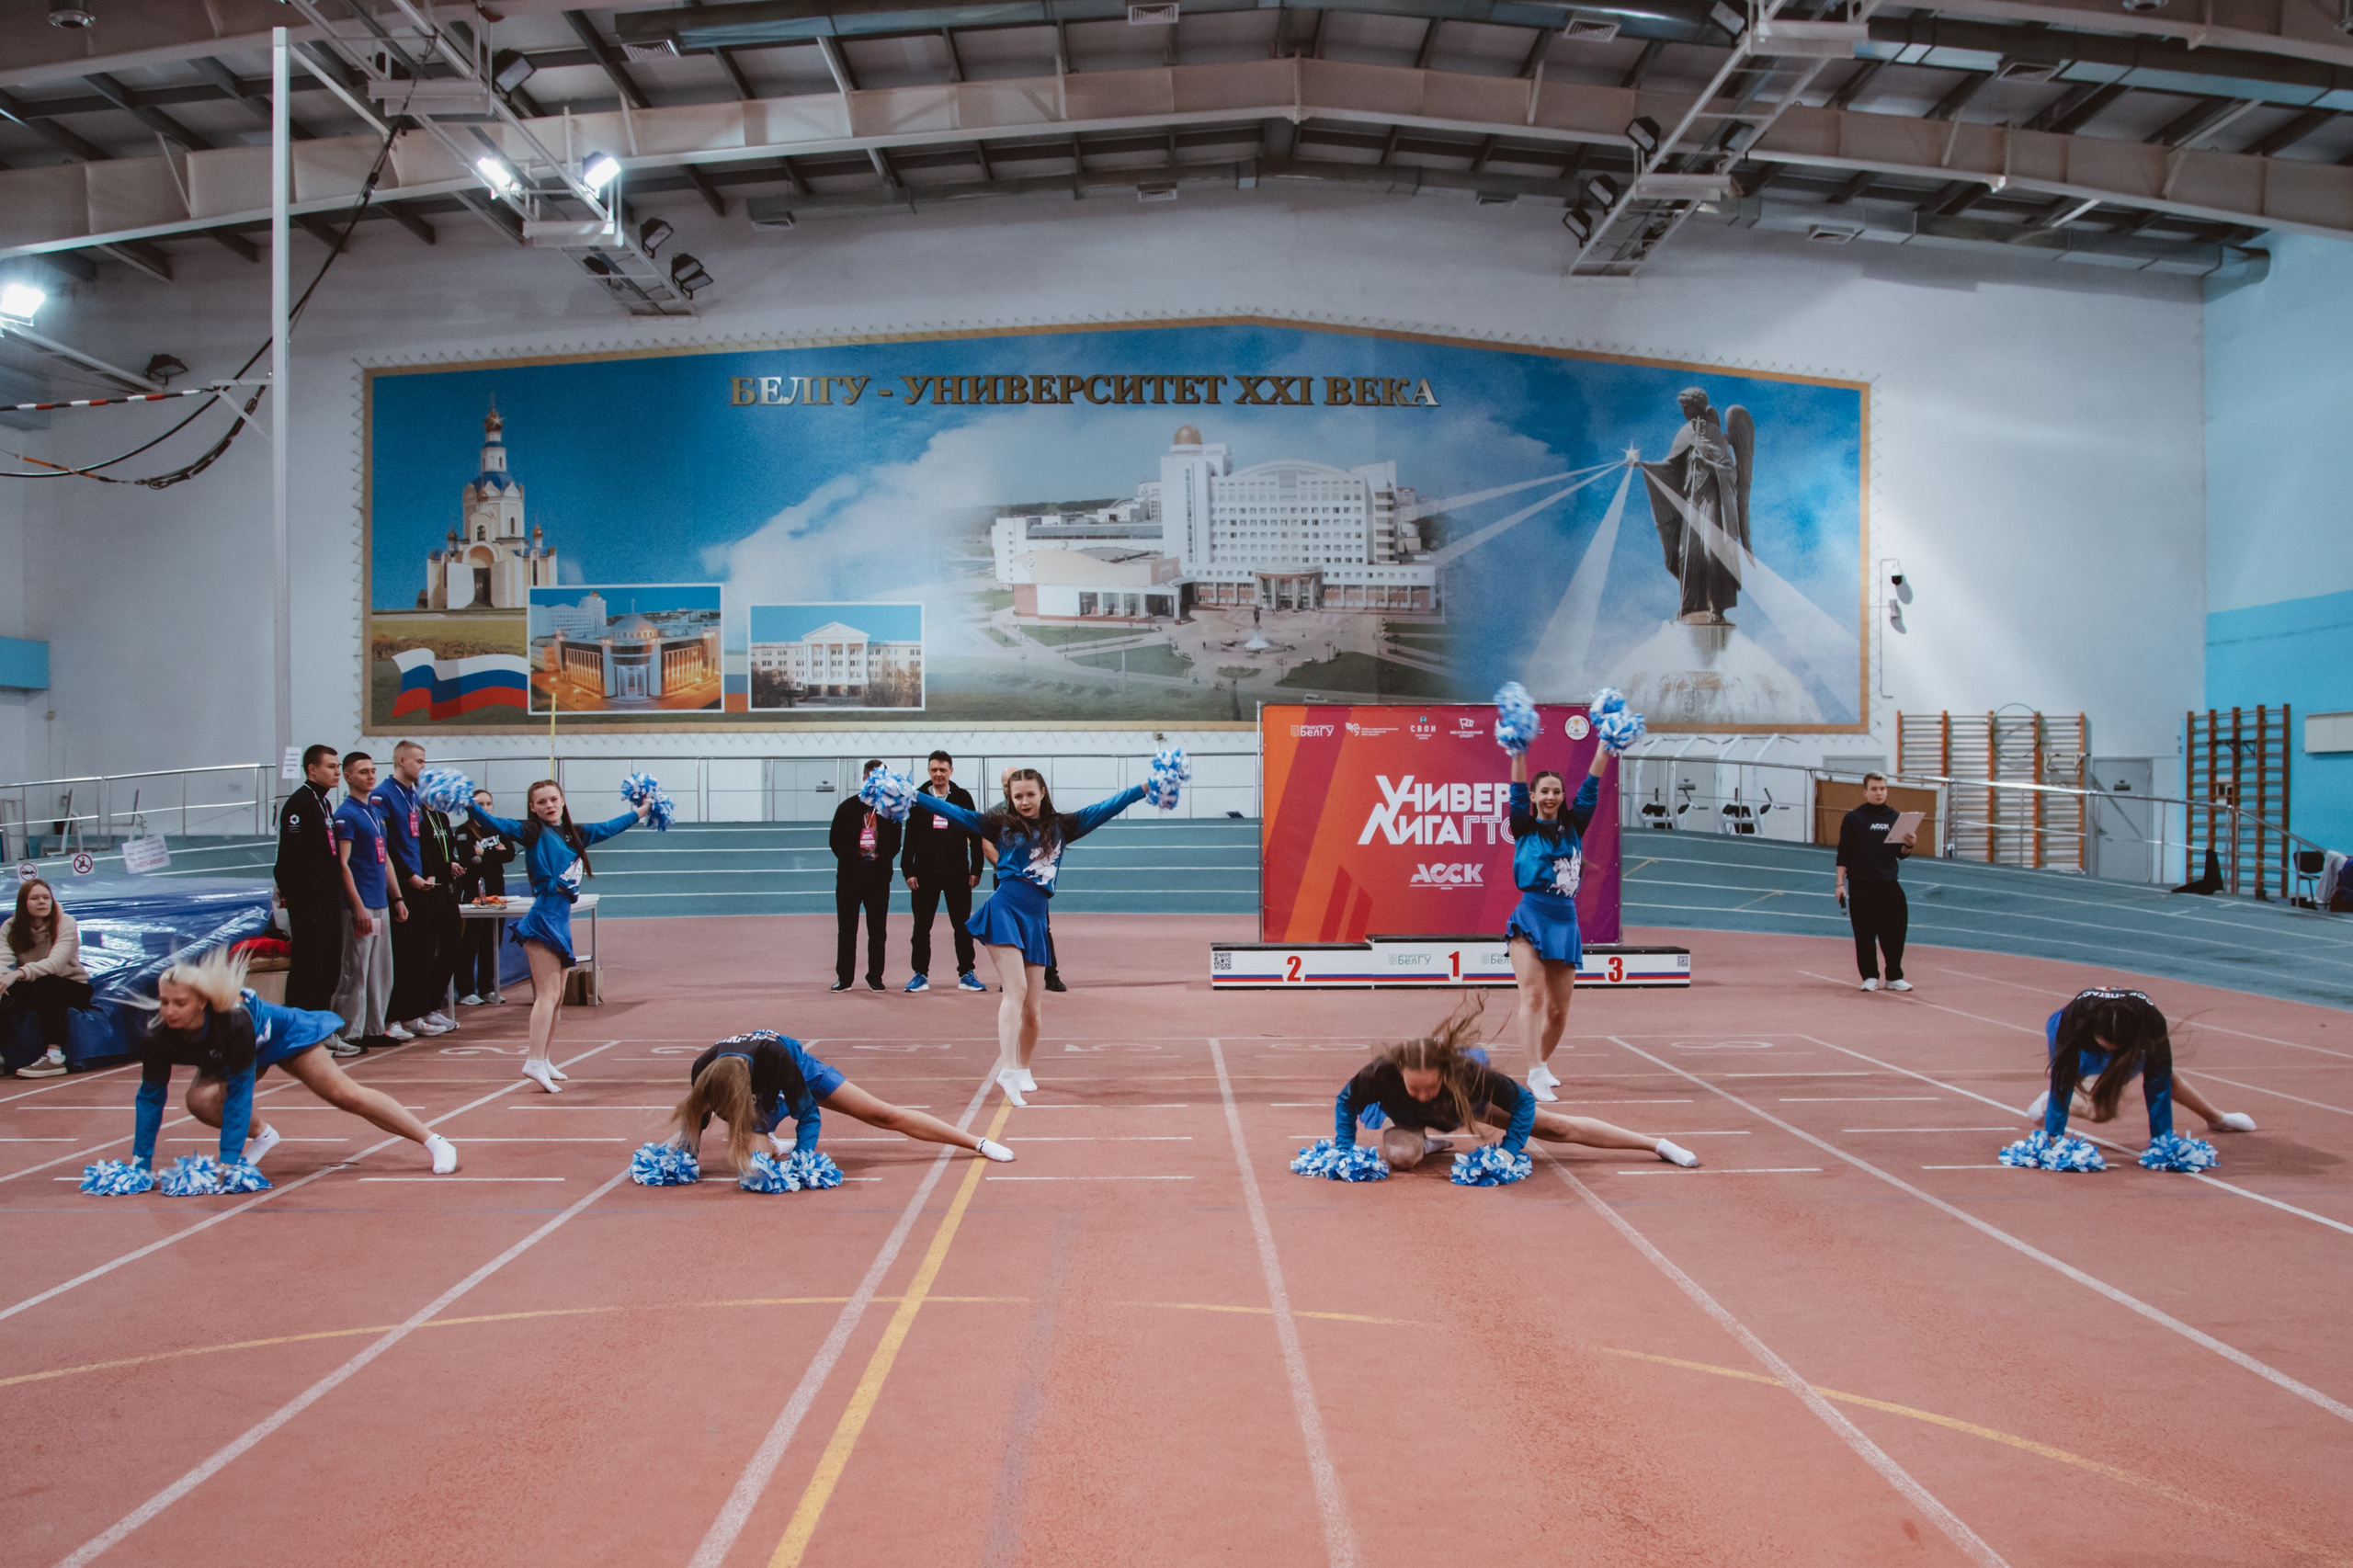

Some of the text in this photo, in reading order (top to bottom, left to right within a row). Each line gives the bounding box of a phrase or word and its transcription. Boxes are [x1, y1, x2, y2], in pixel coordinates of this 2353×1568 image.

[729, 375, 871, 405] БЕЛГУ
[900, 374, 1228, 405] УНИВЕРСИТЕТ
[1322, 376, 1442, 407] ВЕКА
[1300, 724, 1335, 737] БелГУ
[1398, 954, 1432, 965] БелГУ
[1448, 950, 1461, 978] 1
[1490, 953, 1510, 965] Бел
[1287, 955, 1302, 982] 2
[1608, 956, 1623, 983] 3
[851, 1043, 952, 1052] 4
[1065, 1043, 1163, 1052] 5
[1670, 1040, 1776, 1049] 8
